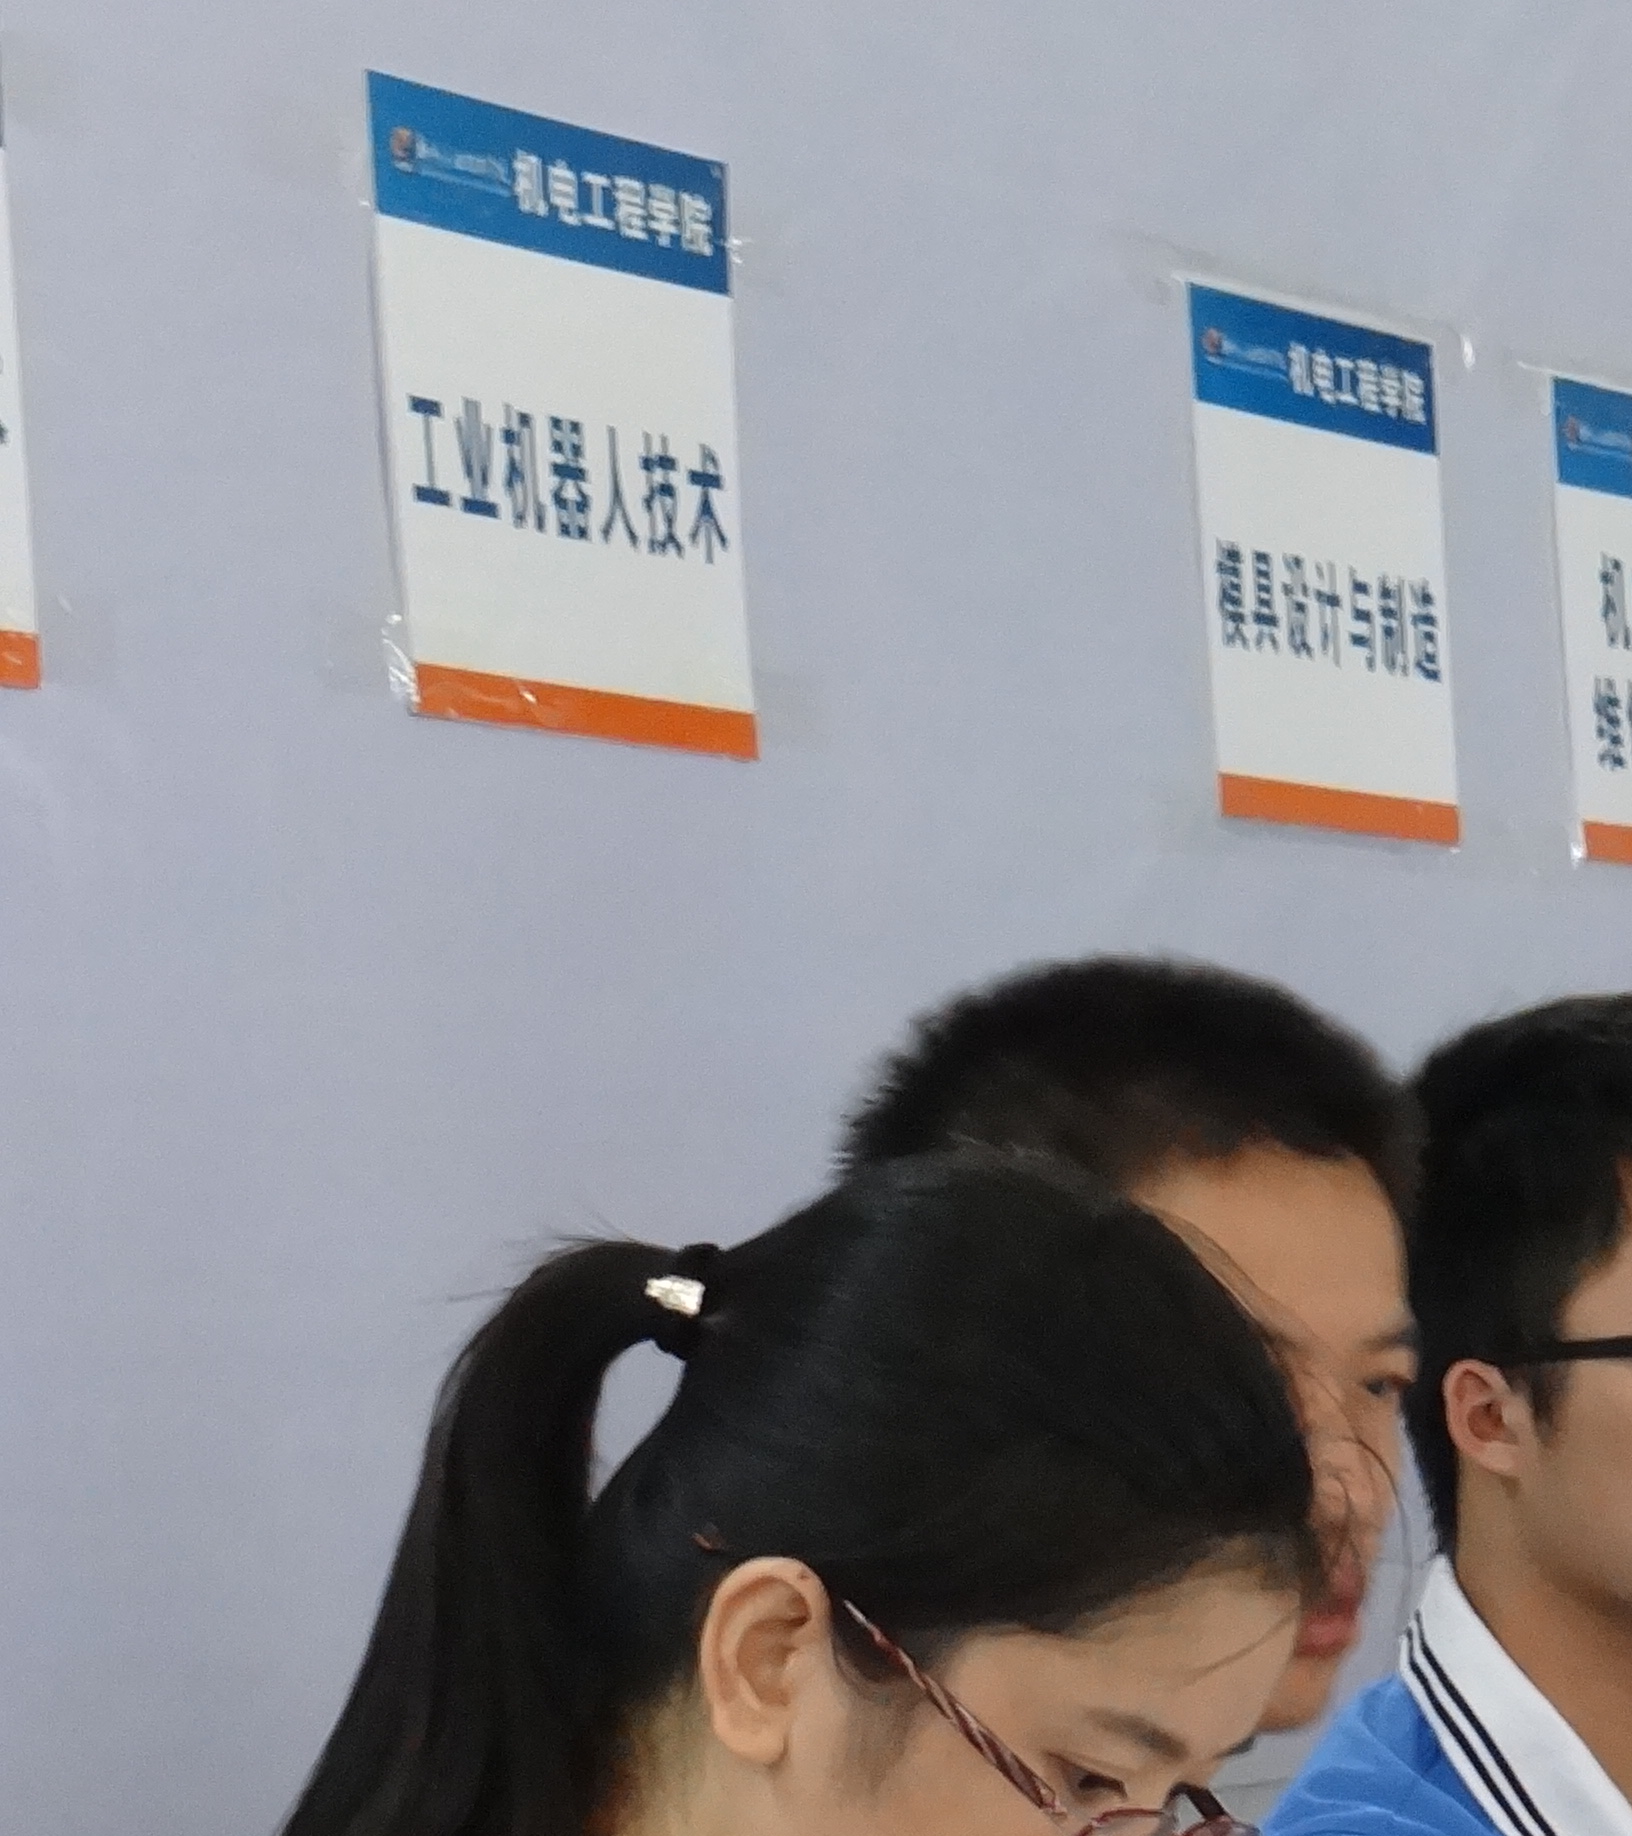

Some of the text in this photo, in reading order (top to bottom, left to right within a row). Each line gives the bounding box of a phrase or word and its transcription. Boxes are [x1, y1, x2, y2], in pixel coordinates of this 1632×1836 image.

[512, 148, 714, 257] 机电工程学院
[1287, 340, 1427, 425] 机电工程学院
[406, 394, 729, 565] 工业机器人技术
[1216, 538, 1443, 683] 模具设计与制造
